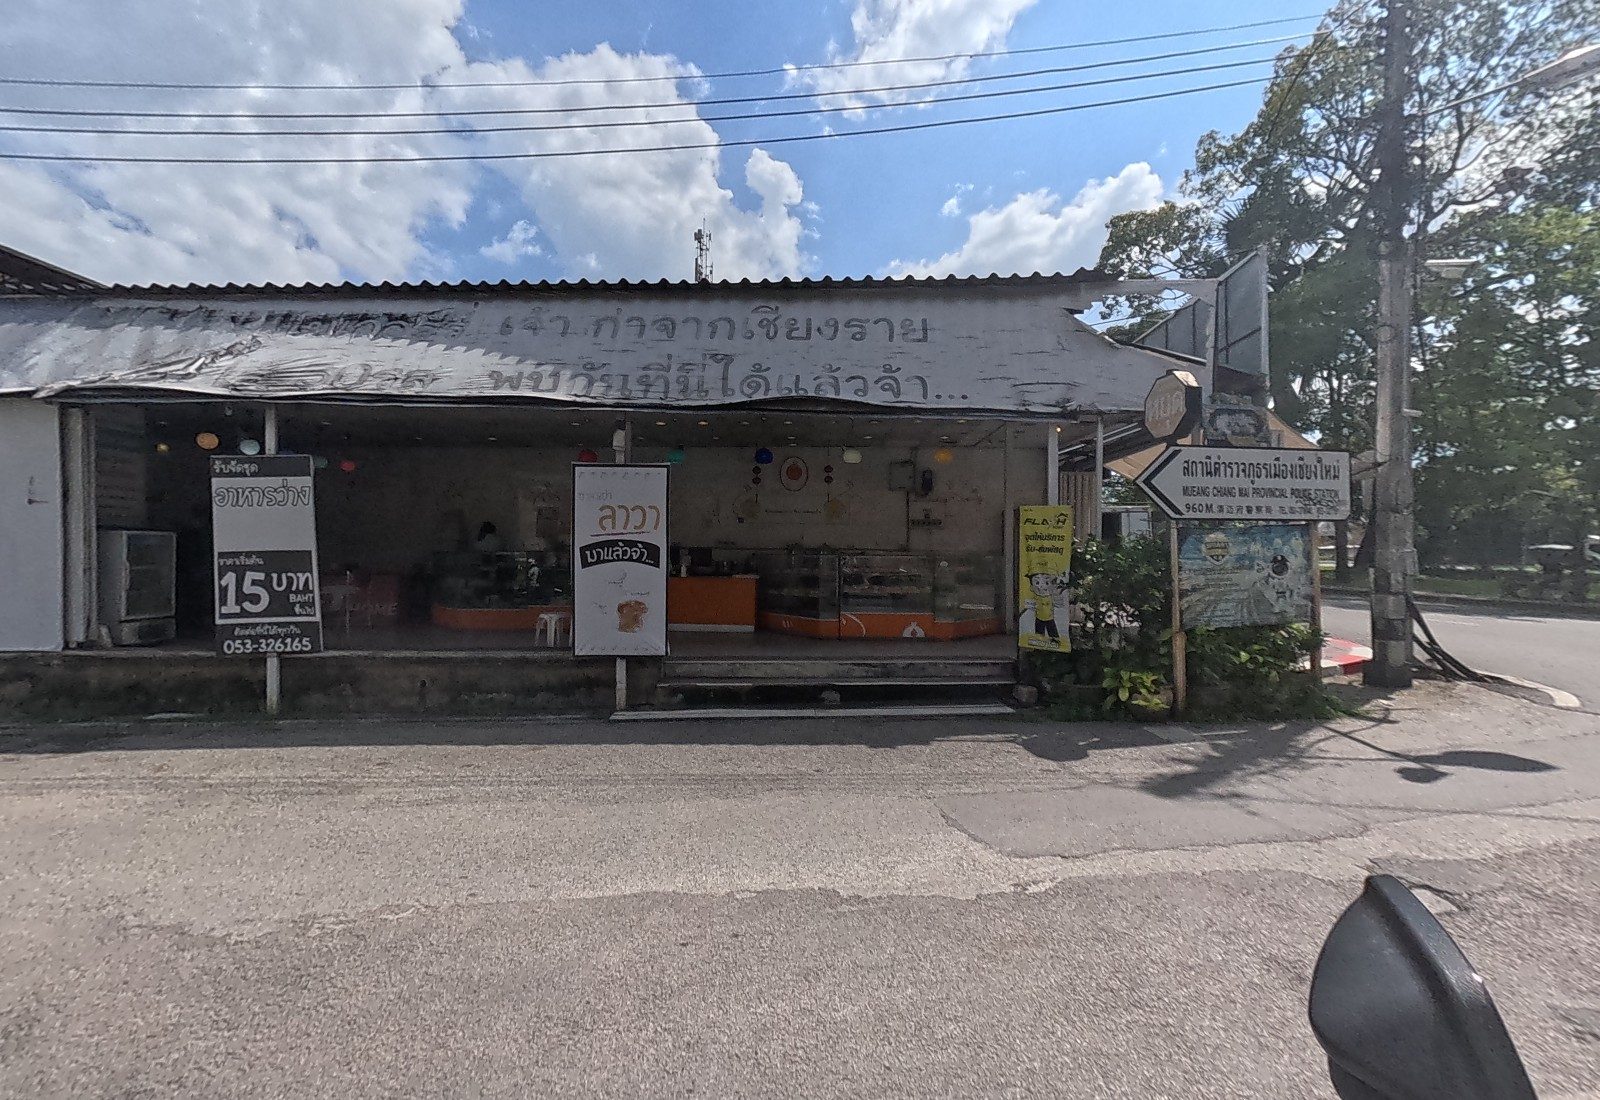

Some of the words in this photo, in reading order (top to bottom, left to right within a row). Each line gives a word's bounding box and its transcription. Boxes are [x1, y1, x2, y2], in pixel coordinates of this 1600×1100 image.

[1181, 455, 1341, 485] สถานีตำรวจภูธรเมืองเชียงใหม่
[213, 478, 312, 508] อาหารว่าง
[1182, 485, 1211, 497] MUEANG
[1212, 486, 1237, 498] CHIANG
[1238, 487, 1250, 498] MAI
[1251, 487, 1288, 499] PROVINCIAL
[598, 504, 661, 532] ลาวา
[584, 541, 654, 564] มาแล้วจ้า...
[219, 571, 270, 614] 15
[270, 571, 314, 592] บาท
[288, 593, 314, 603] BAHT
[222, 637, 313, 655] 053-326165
